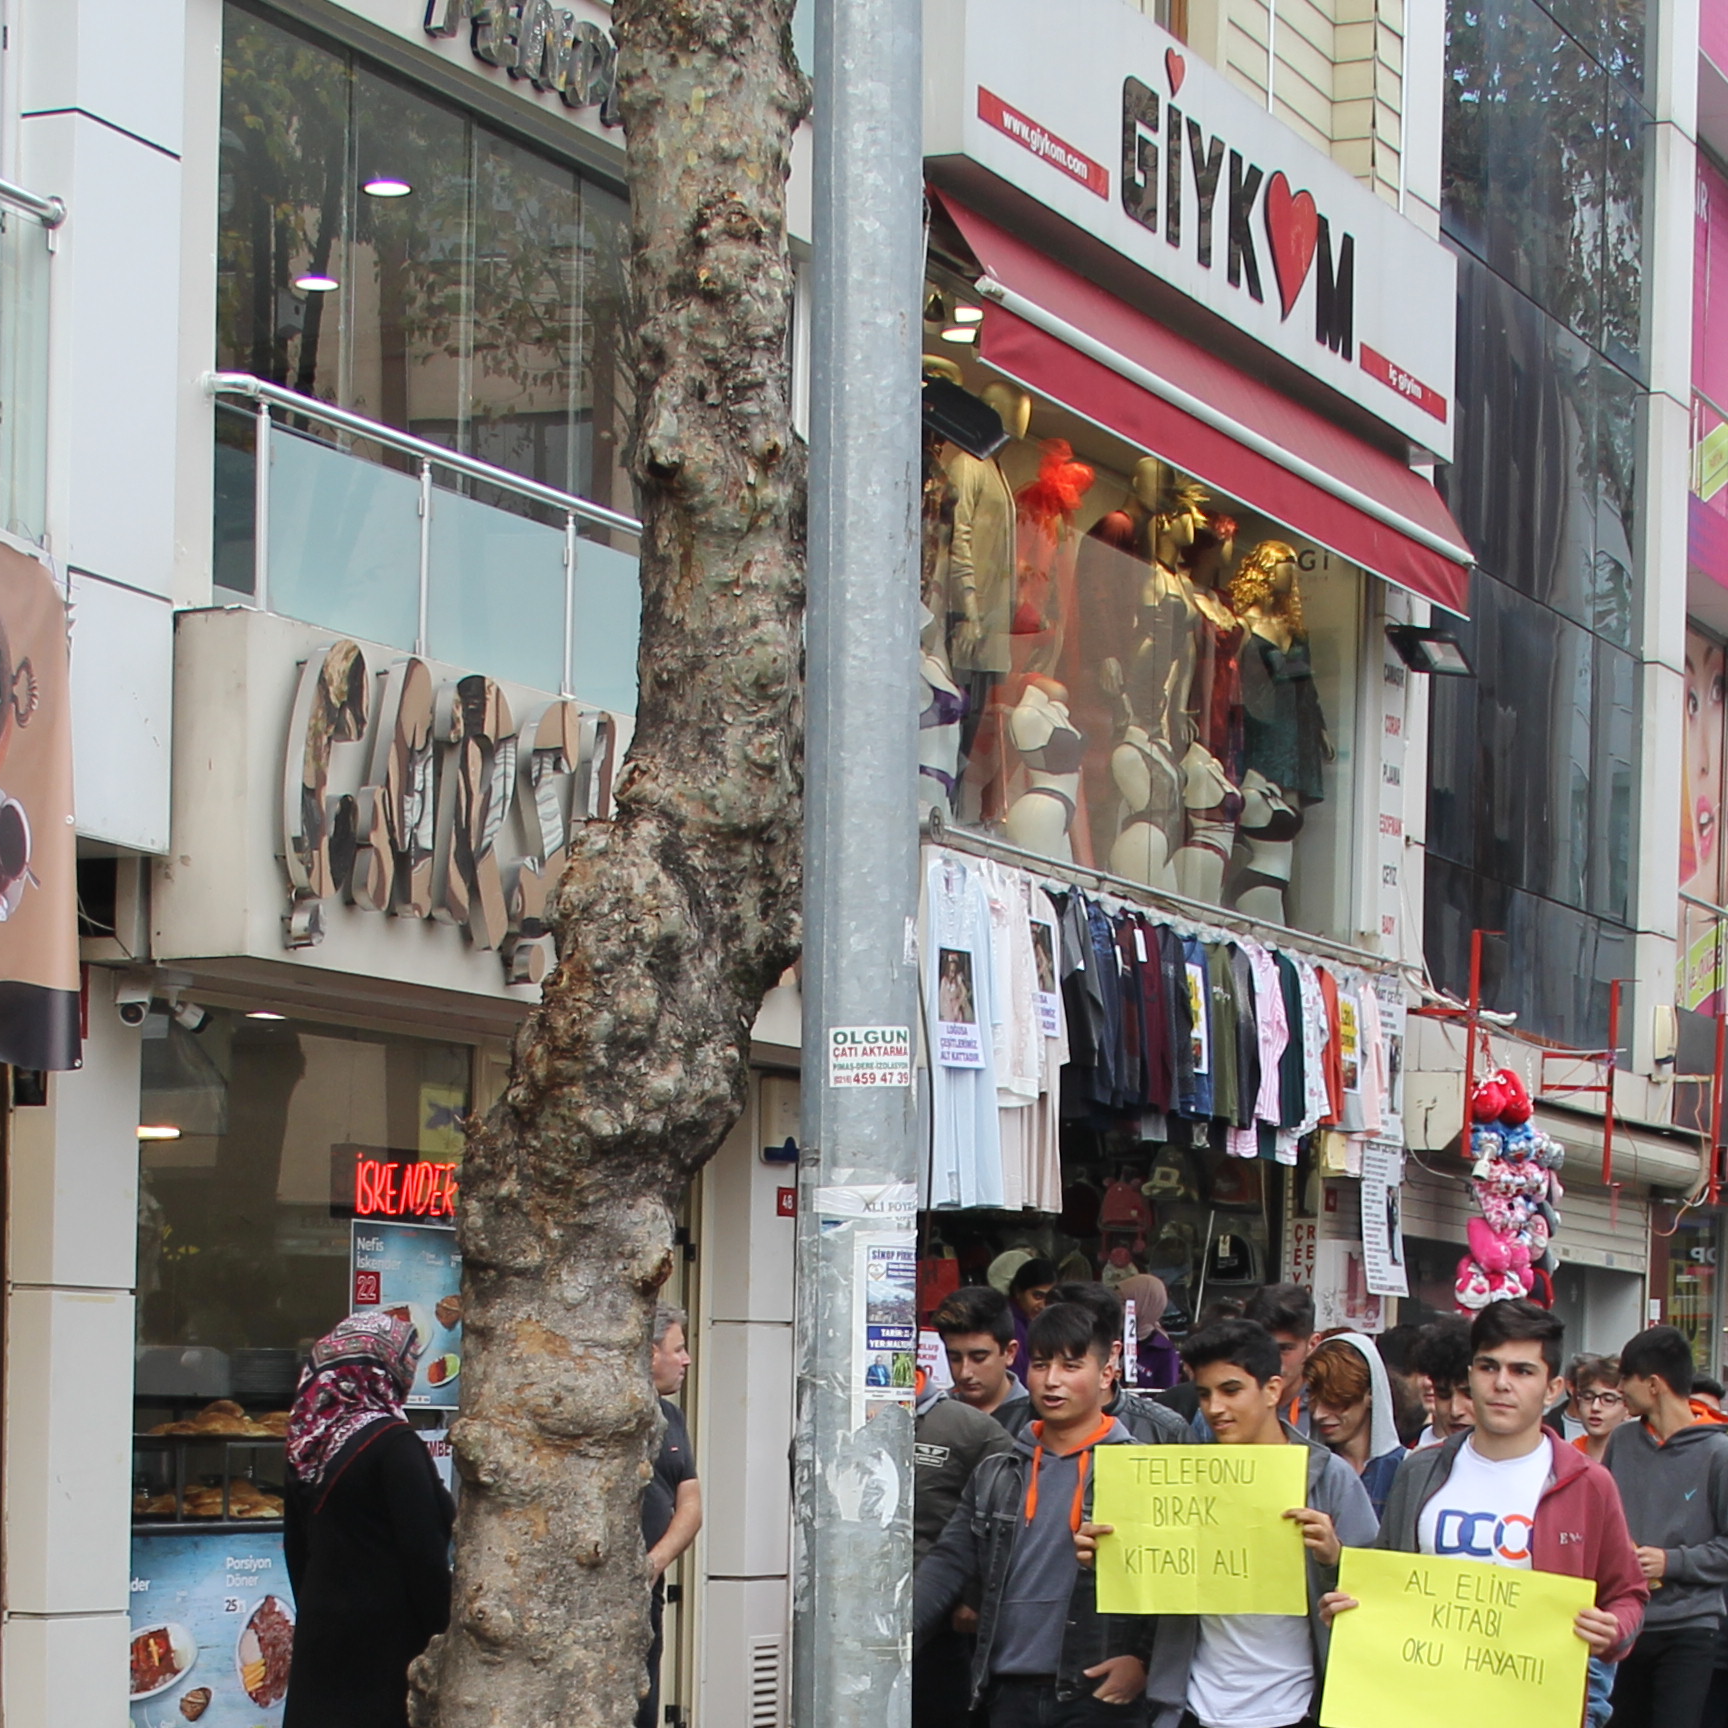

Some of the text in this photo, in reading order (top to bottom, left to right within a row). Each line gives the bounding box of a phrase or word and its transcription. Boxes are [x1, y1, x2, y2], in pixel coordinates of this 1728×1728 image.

[1002, 110, 1089, 180] www.giykom.com
[833, 1030, 908, 1045] OLGUN
[833, 1045, 908, 1061] ÇATI AKTARMA
[853, 1072, 877, 1086] 459
[880, 1071, 894, 1085] 47
[897, 1071, 909, 1085] 39
[356, 1235, 384, 1252] Nefis
[356, 1250, 403, 1271] İskender
[357, 1274, 377, 1302] 22
[1129, 1456, 1257, 1486] TELEFONU
[1152, 1496, 1220, 1527] BIRAK
[225, 1556, 273, 1572] Porsiyon
[1124, 1544, 1249, 1579] KİTABI AL!
[225, 1573, 260, 1588] Döner
[1404, 1569, 1522, 1608] AL ELİNE
[225, 1598, 239, 1613] 25
[1430, 1601, 1503, 1639] KİTABI
[1401, 1637, 1545, 1686] OKU HAYATI!
